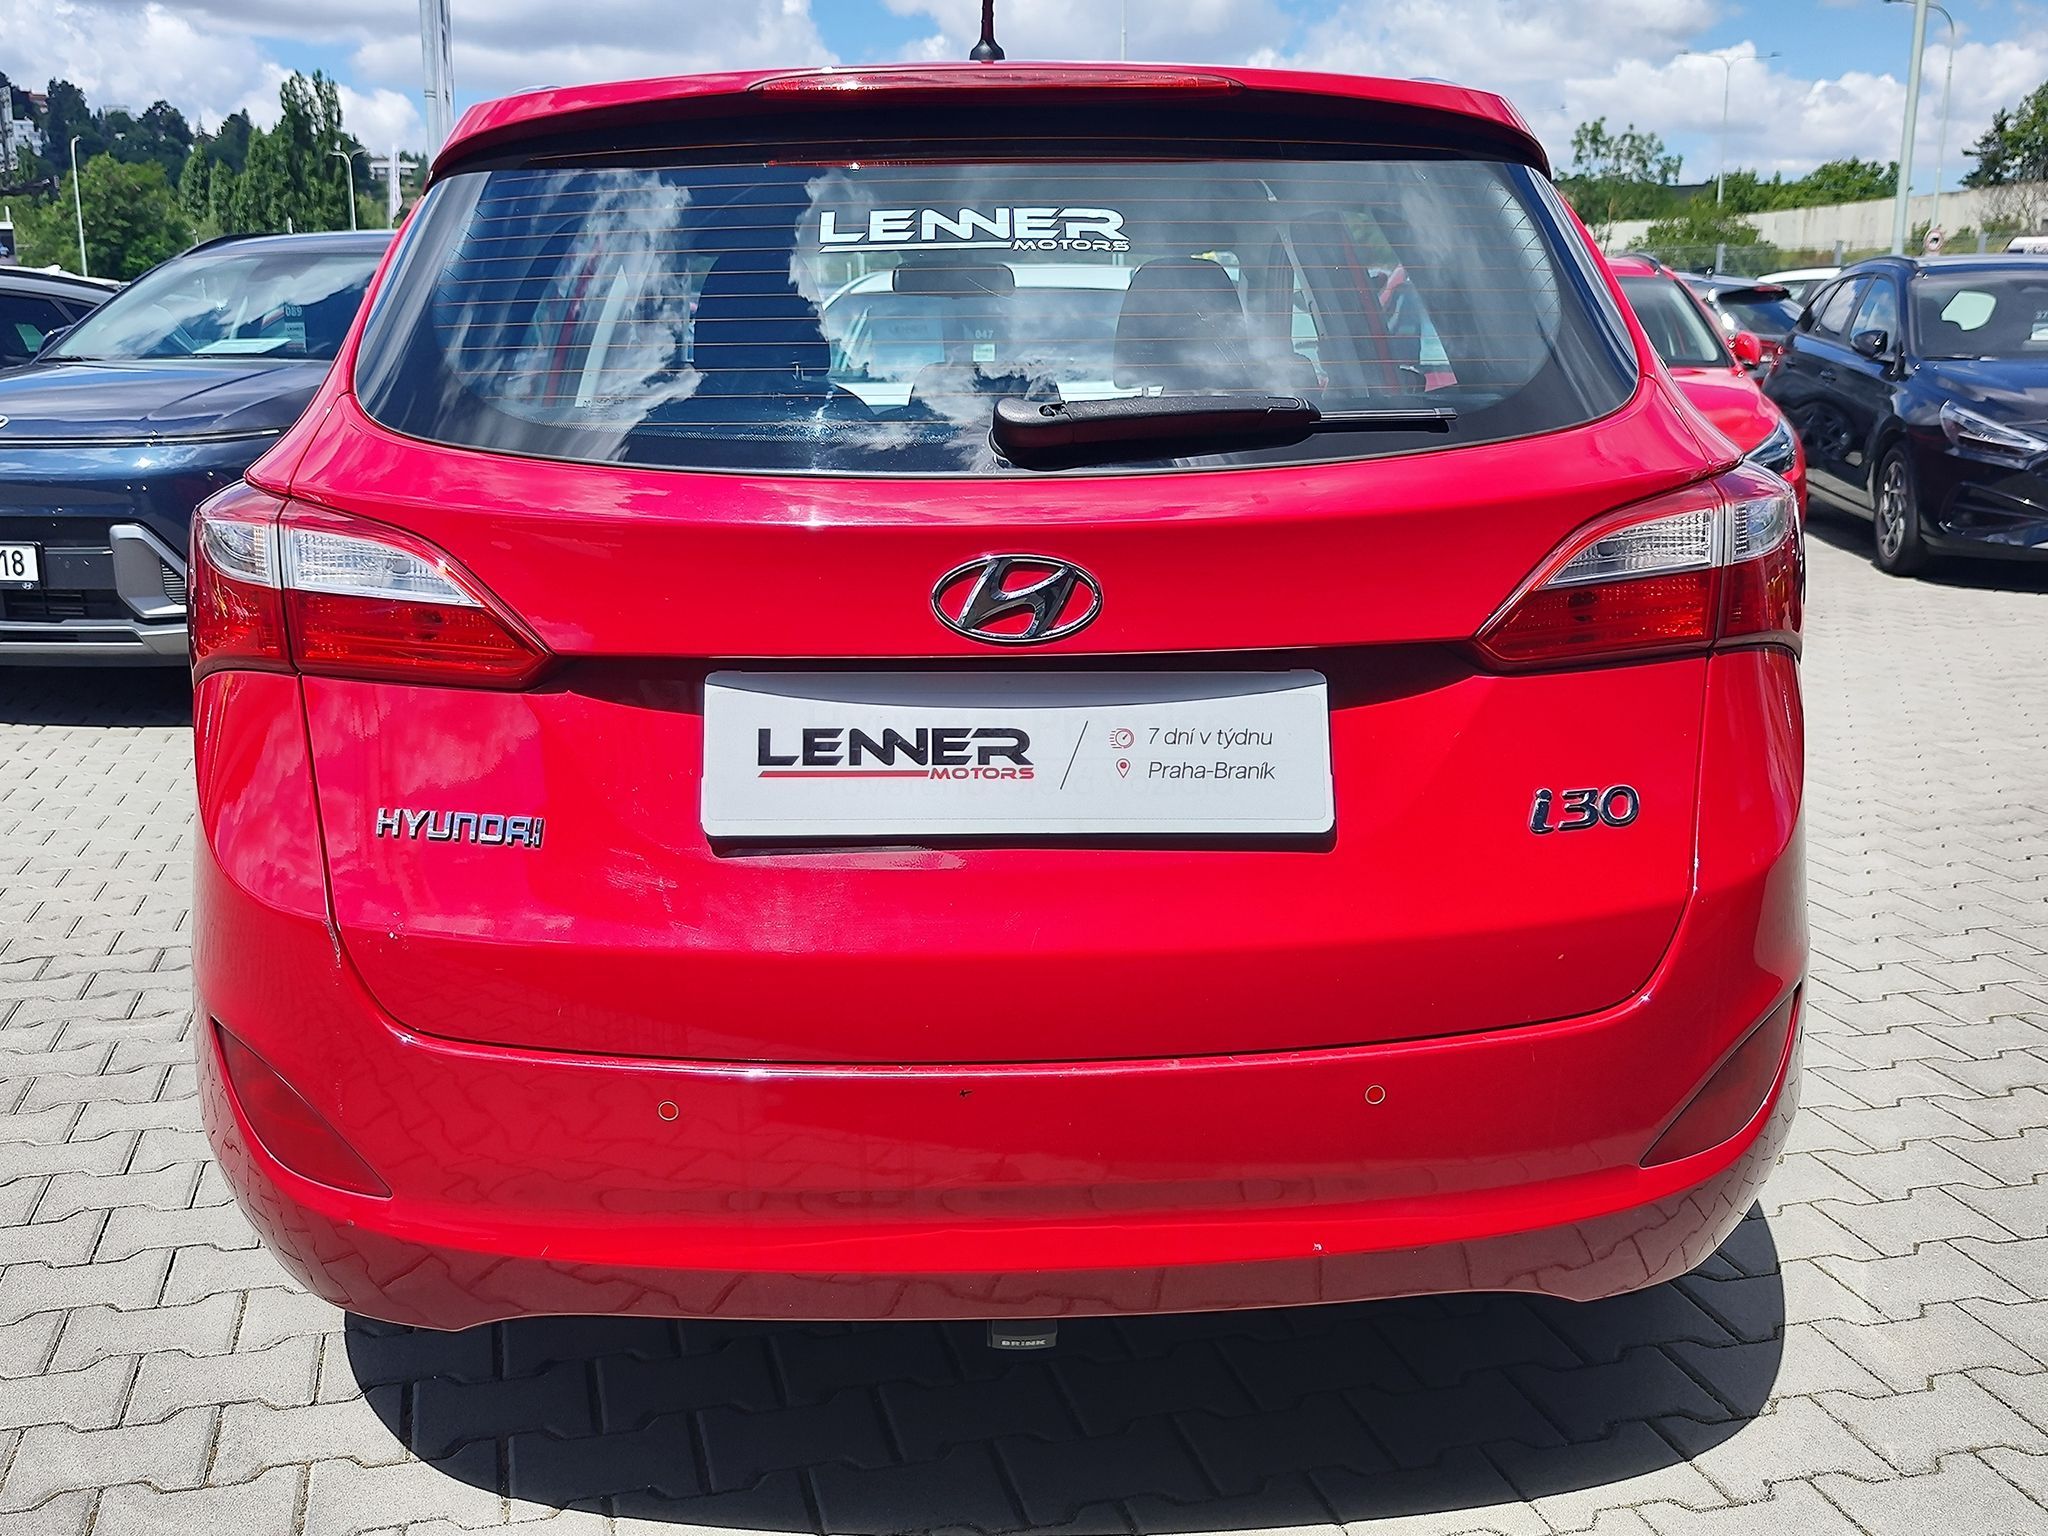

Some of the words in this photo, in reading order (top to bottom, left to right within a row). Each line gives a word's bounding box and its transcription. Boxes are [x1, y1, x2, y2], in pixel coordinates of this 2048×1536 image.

[819, 207, 1130, 244] LENNER
[1011, 238, 1131, 252] MOTORS
[757, 727, 1035, 767] LENNER
[1148, 727, 1161, 745] 7
[1164, 727, 1196, 745] dní
[1199, 731, 1212, 745] v
[1216, 727, 1273, 749] týdnu
[929, 767, 1036, 780] MOTORS
[1148, 761, 1276, 780] Praha-Braník
[1528, 784, 1641, 836] i30
[375, 807, 545, 849] HYUNDAI
